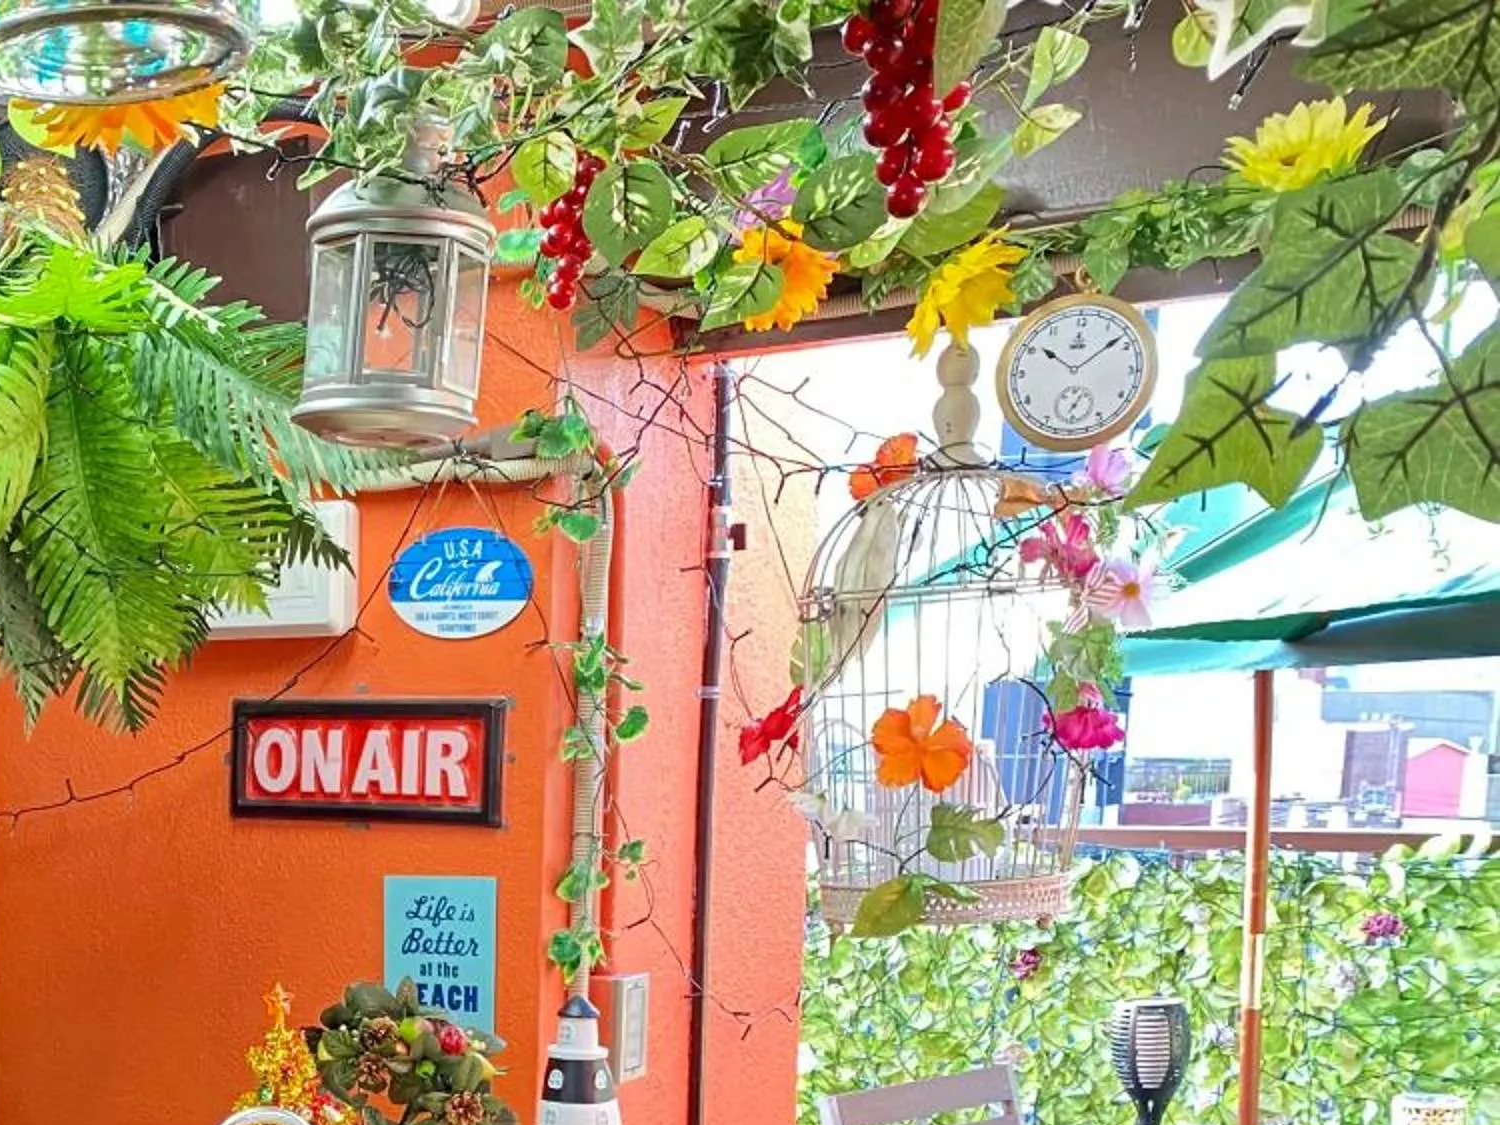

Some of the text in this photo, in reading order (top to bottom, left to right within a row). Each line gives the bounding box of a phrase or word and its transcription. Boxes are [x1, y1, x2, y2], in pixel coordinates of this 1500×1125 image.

[409, 557, 501, 602] California
[253, 725, 469, 798] ON AIR
[405, 895, 476, 928] Life is
[401, 927, 480, 957] Better
[419, 961, 460, 979] at the
[415, 982, 479, 1013] EACH
